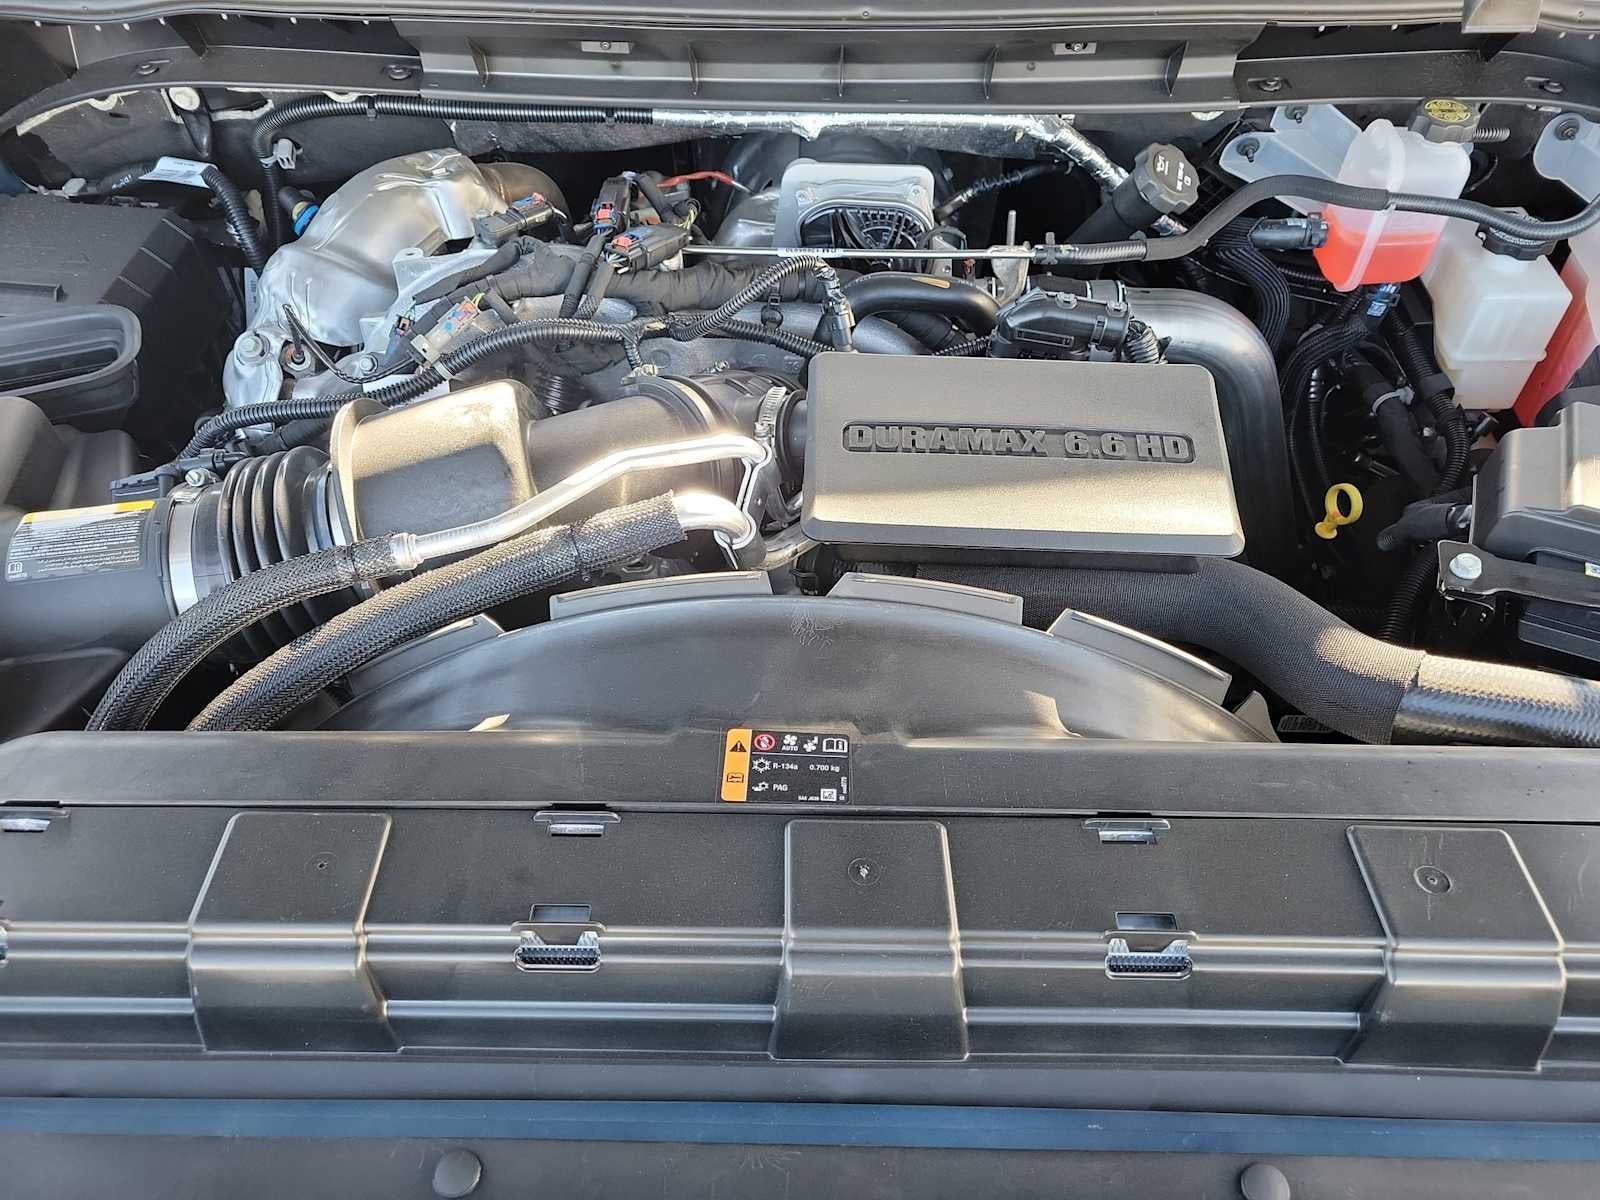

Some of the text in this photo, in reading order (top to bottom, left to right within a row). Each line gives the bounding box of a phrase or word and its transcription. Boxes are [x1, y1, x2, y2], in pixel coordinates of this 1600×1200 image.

[848, 425, 1190, 461] DURAMAX 6.6 HD
[772, 763, 799, 771] R-134a
